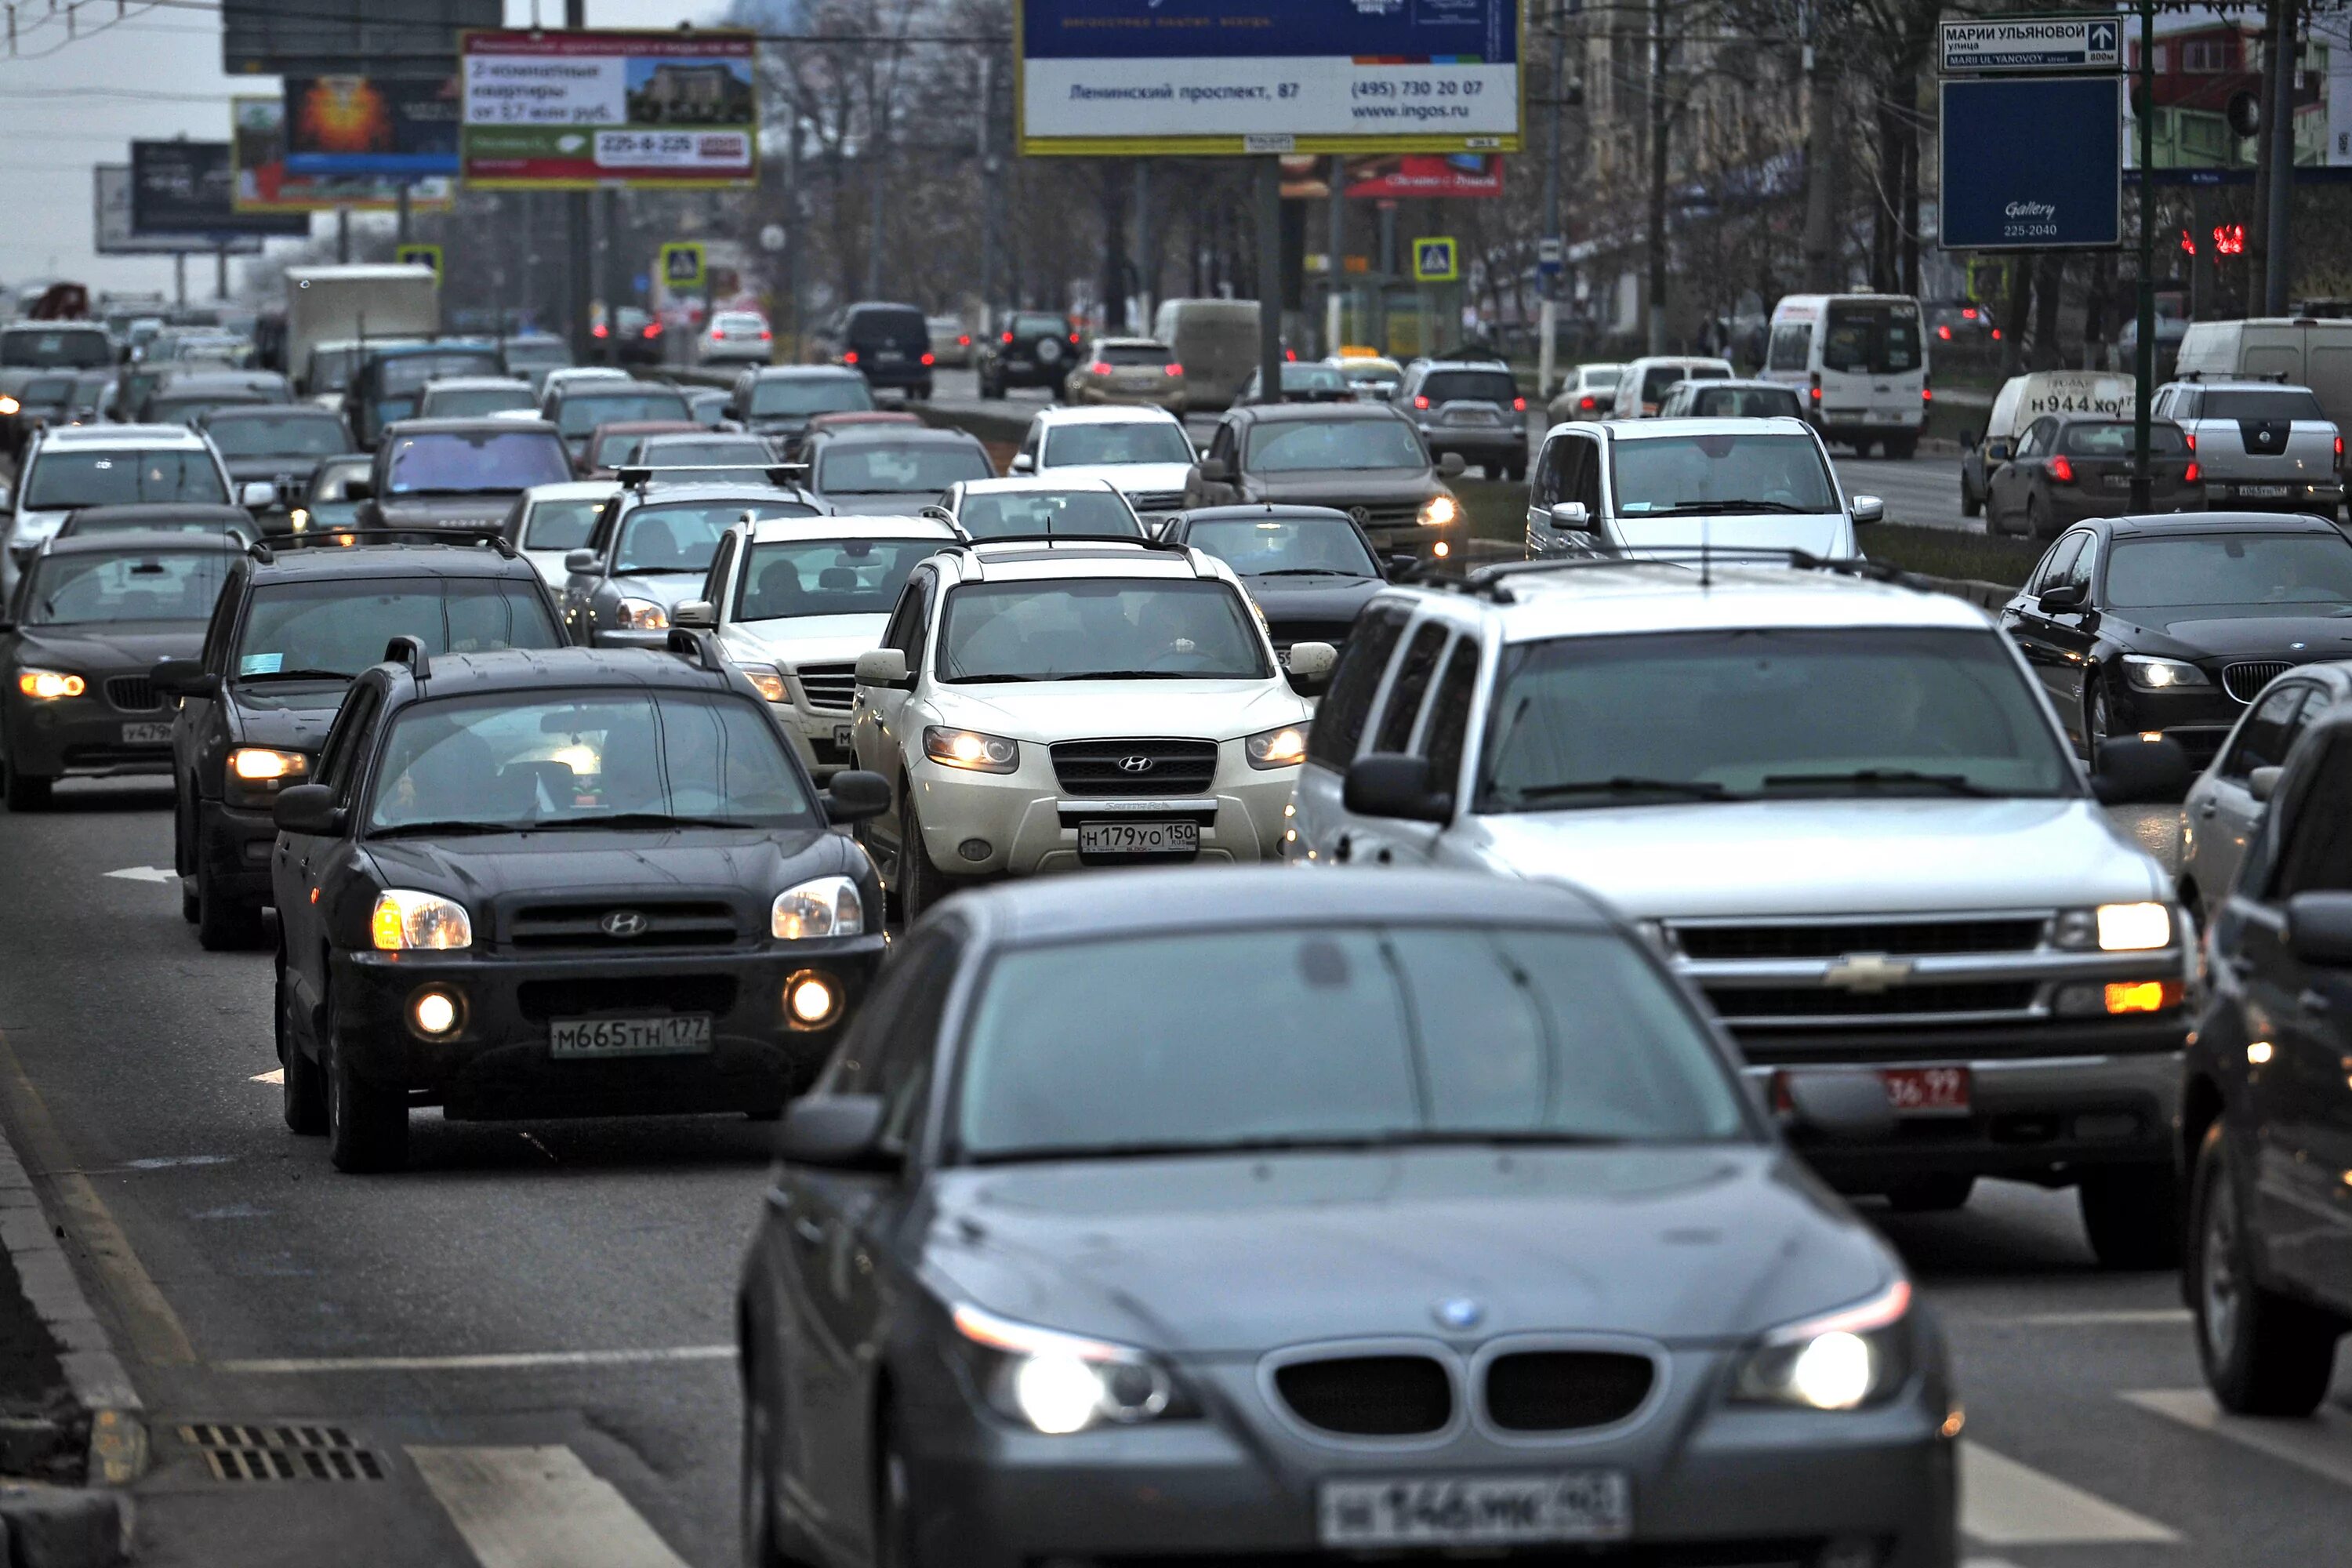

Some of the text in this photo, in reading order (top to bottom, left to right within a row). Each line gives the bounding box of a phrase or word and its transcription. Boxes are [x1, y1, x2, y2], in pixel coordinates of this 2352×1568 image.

[1946, 22, 2085, 41] МАРИИ УЛЬЯНОВОЙ
[1947, 42, 1980, 51] улица
[2090, 53, 2114, 61] 800м
[1069, 83, 1299, 103] Ленинский проспект, 87
[1351, 80, 1483, 99] (495) 730 20 07
[1351, 103, 1469, 120] www.ingos.ru
[2005, 201, 2055, 220] Gallery
[2004, 224, 2056, 236] 225-2040
[1166, 825, 1193, 840] 150
[668, 1018, 704, 1039] 177
